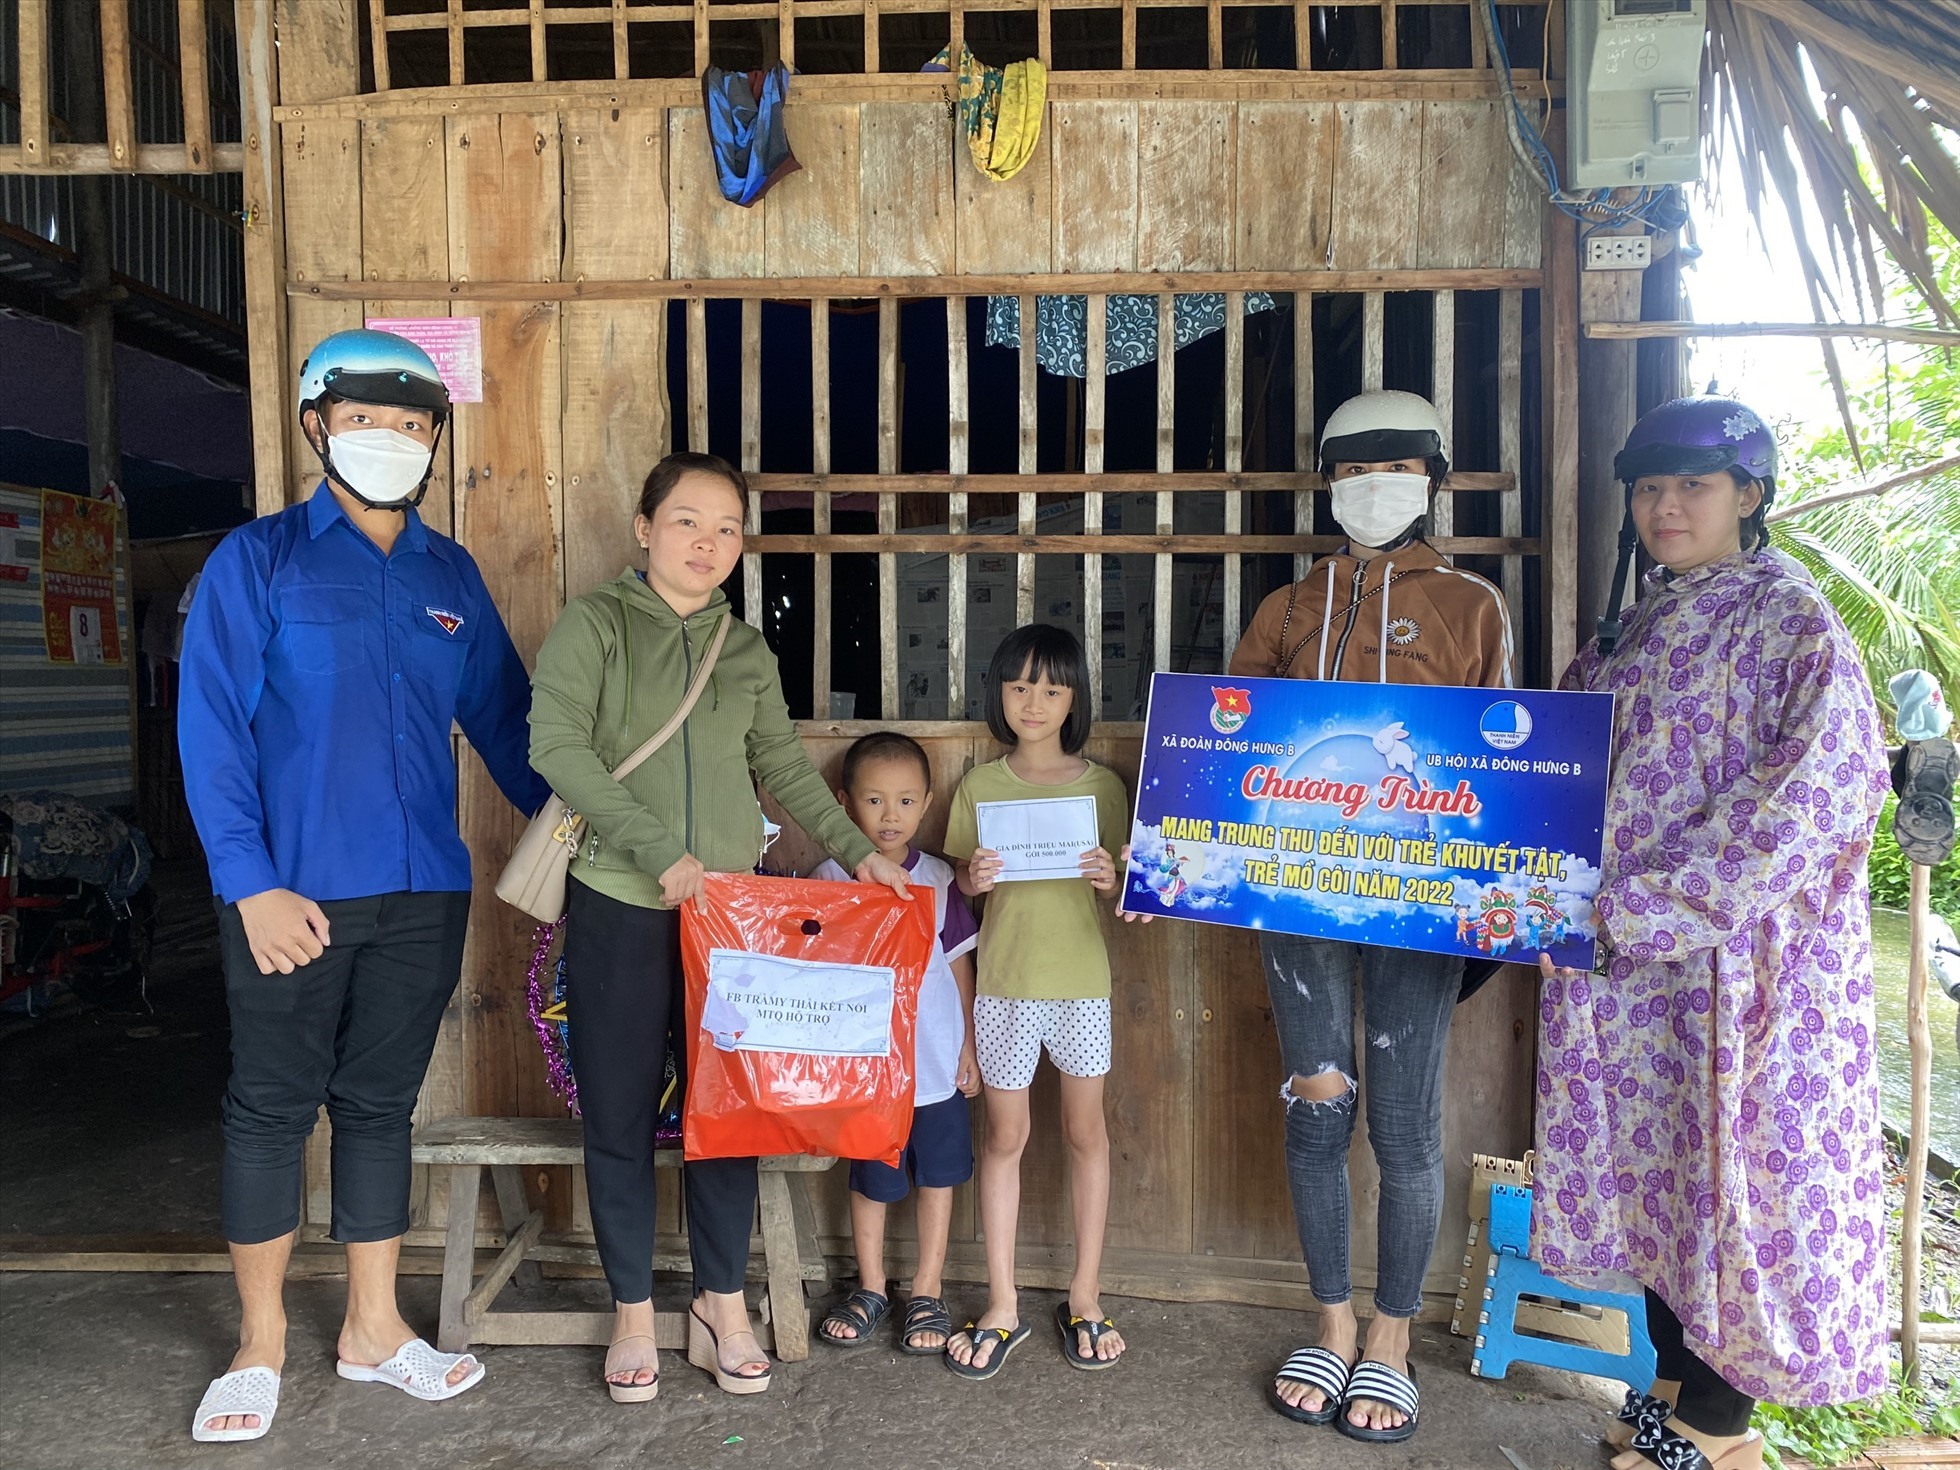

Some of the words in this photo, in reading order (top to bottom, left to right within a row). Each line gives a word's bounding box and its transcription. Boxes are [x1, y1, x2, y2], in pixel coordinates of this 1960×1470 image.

[79, 613, 89, 637] 8
[1363, 645, 1401, 657] SHIING
[1403, 650, 1428, 663] FANG
[1162, 734, 1177, 748] XÃ
[1180, 735, 1212, 750] ĐOÀN
[1252, 742, 1285, 755] HƯNG
[1287, 744, 1295, 756] B
[1426, 754, 1442, 766] UB
[1445, 753, 1467, 771] HỘI
[1470, 755, 1488, 770] XÃ
[1491, 756, 1530, 772] ĐÔNG
[1533, 760, 1570, 775] HƯNG
[1573, 763, 1582, 776] B
[1242, 764, 1369, 820] Chương
[1377, 774, 1482, 818] Trình
[1160, 815, 1213, 843] MANG
[1217, 821, 1276, 850] TRUNG
[1280, 827, 1316, 853] THU
[1318, 826, 1359, 858] ĐẾN
[1363, 832, 1395, 862] VỚI
[1399, 833, 1438, 867] TRẺ
[1441, 841, 1520, 874] KHUYẾT
[1524, 846, 1568, 882] TẬT,
[1244, 854, 1280, 886] TRẺ
[1283, 859, 1315, 890] MỒ
[1317, 866, 1350, 894] CÔI
[1354, 869, 1401, 900] NĂM
[1404, 878, 1454, 906] 2022
[726, 992, 741, 1003] FB
[757, 1009, 783, 1022] MTQ
[805, 1013, 831, 1026] TRỢ
